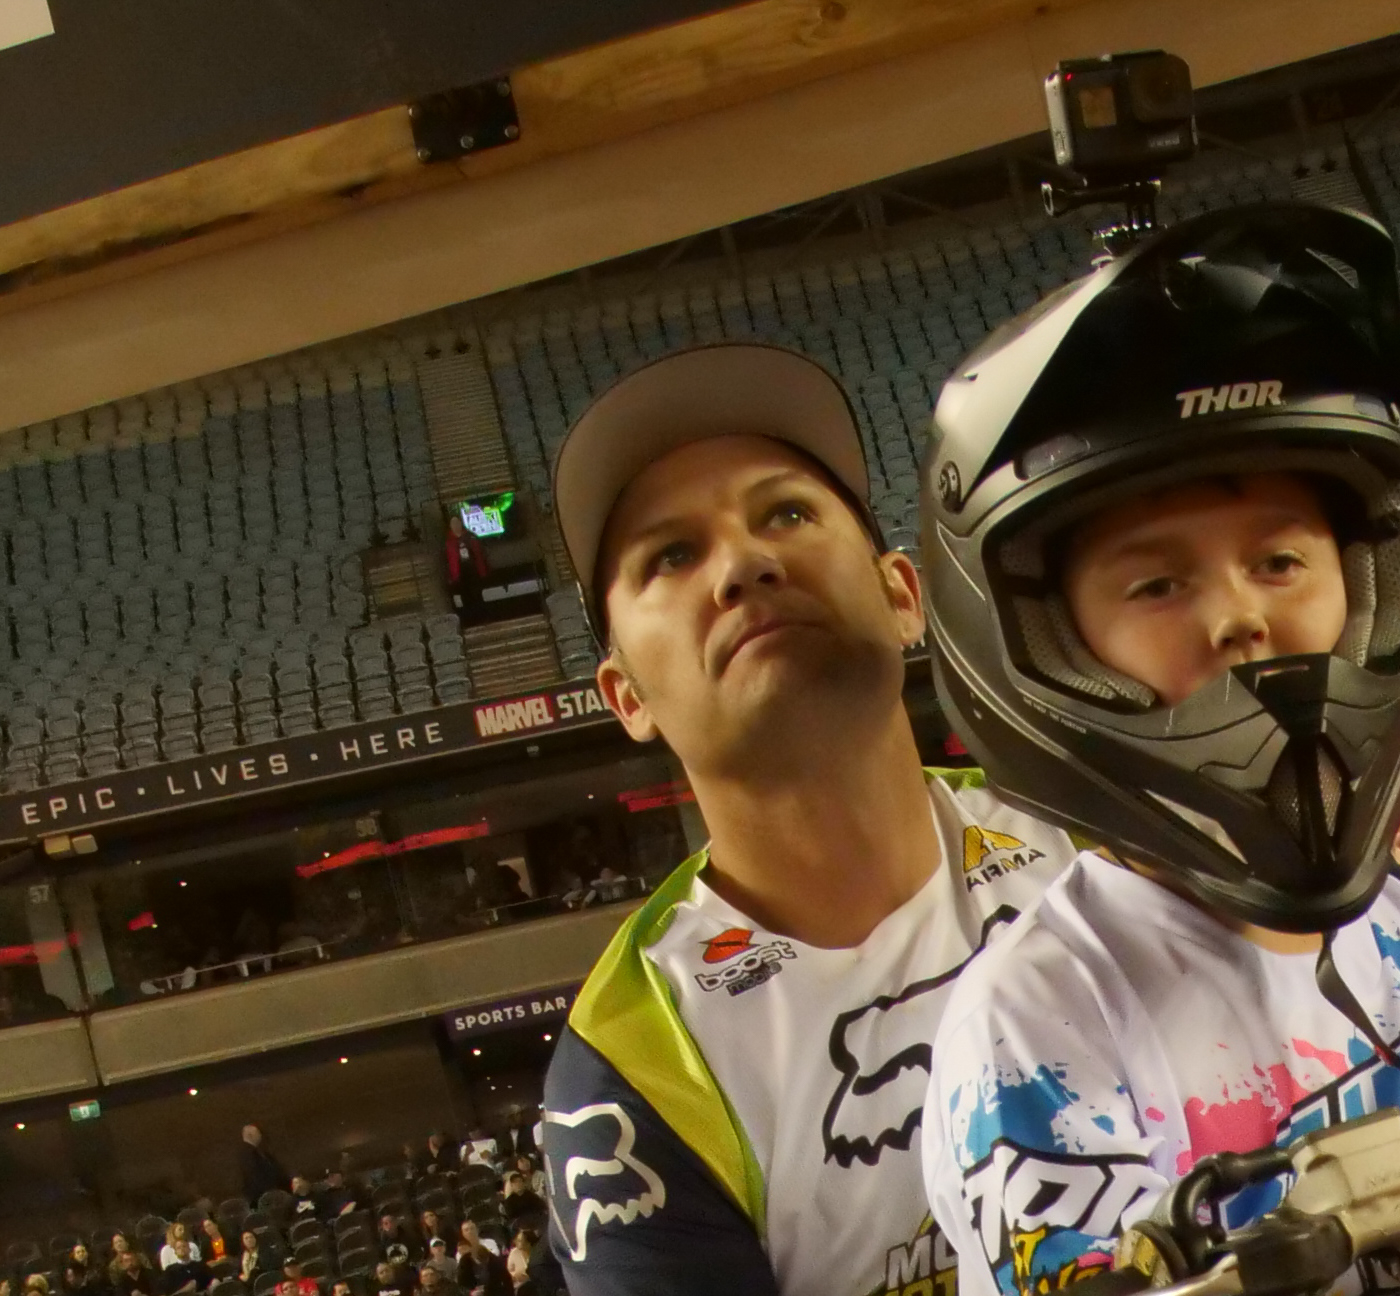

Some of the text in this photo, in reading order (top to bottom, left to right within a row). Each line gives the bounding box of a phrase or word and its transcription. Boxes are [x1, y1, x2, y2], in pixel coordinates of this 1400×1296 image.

[1176, 380, 1283, 419] THOR
[475, 695, 554, 738] MARVEL
[22, 721, 445, 825] EPIC LIVES HERE
[966, 846, 1047, 893] ARMA
[694, 940, 798, 993] boost
[455, 995, 568, 1031] SPORTS BAR
